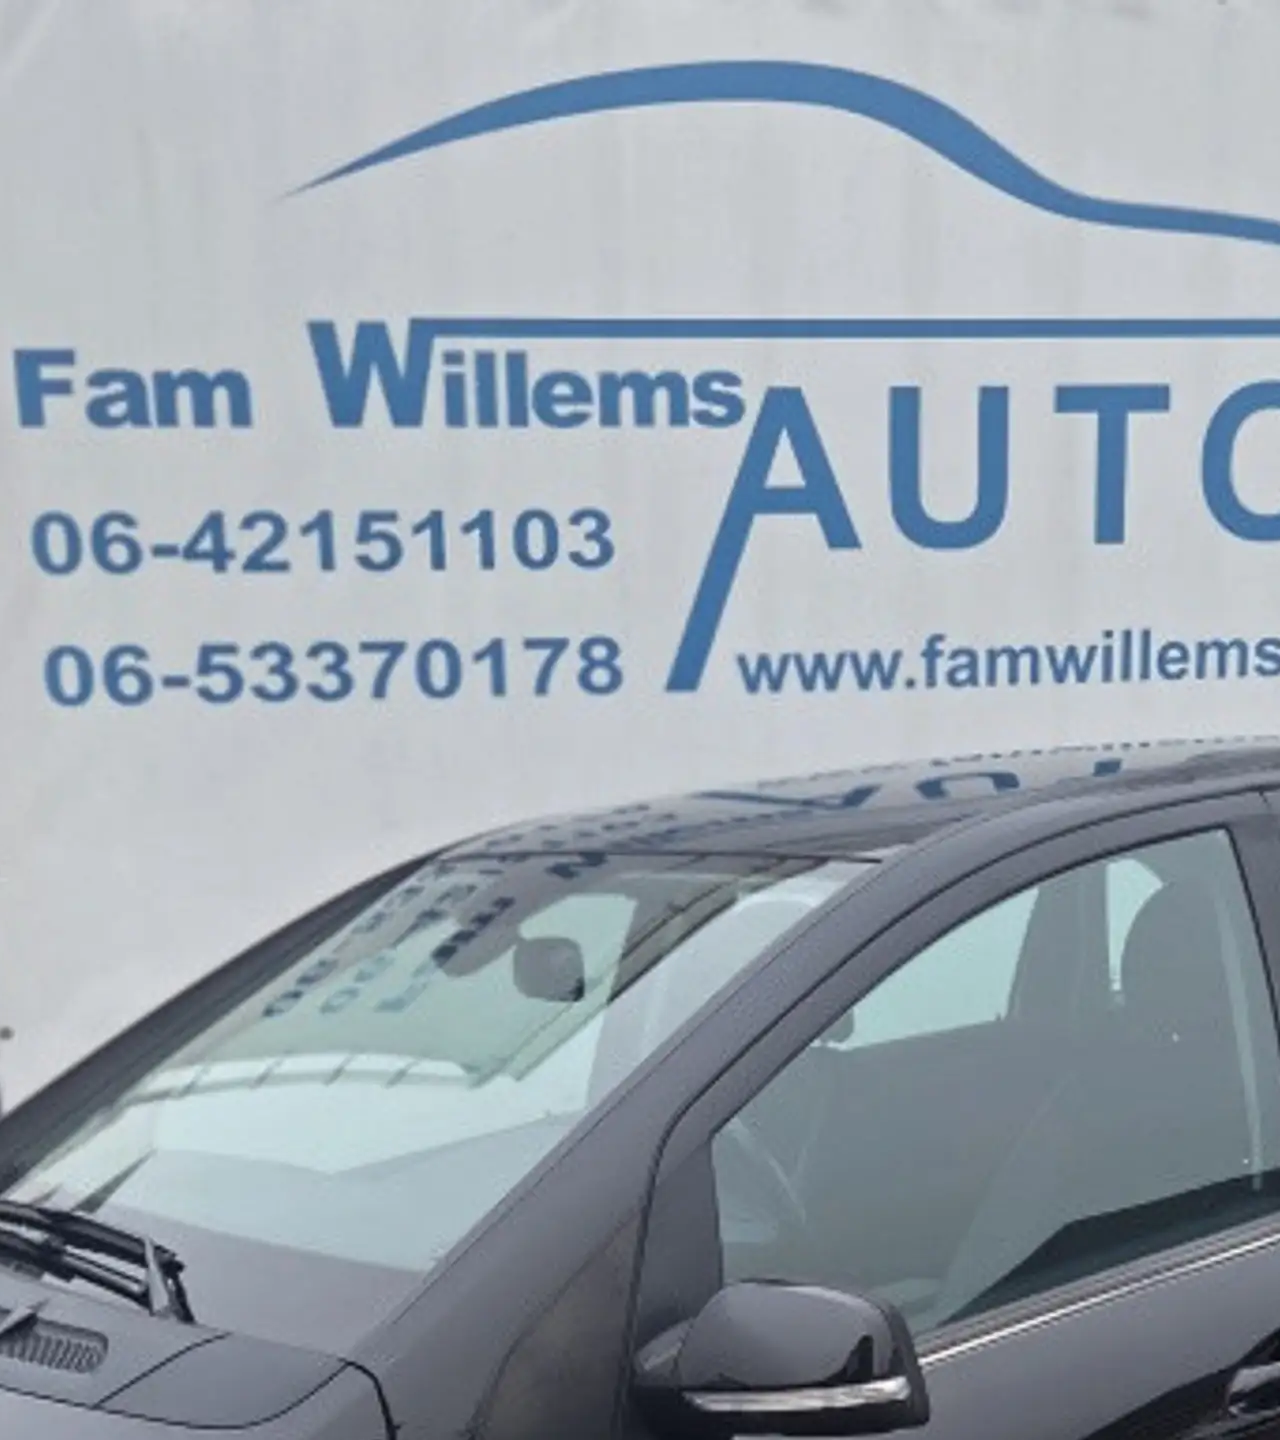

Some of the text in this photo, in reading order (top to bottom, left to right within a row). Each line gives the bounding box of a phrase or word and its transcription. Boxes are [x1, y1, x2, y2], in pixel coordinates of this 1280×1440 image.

[12, 316, 746, 430] Fam Willems
[30, 507, 616, 577] 06-42151103
[42, 635, 625, 708] 06-53370178
